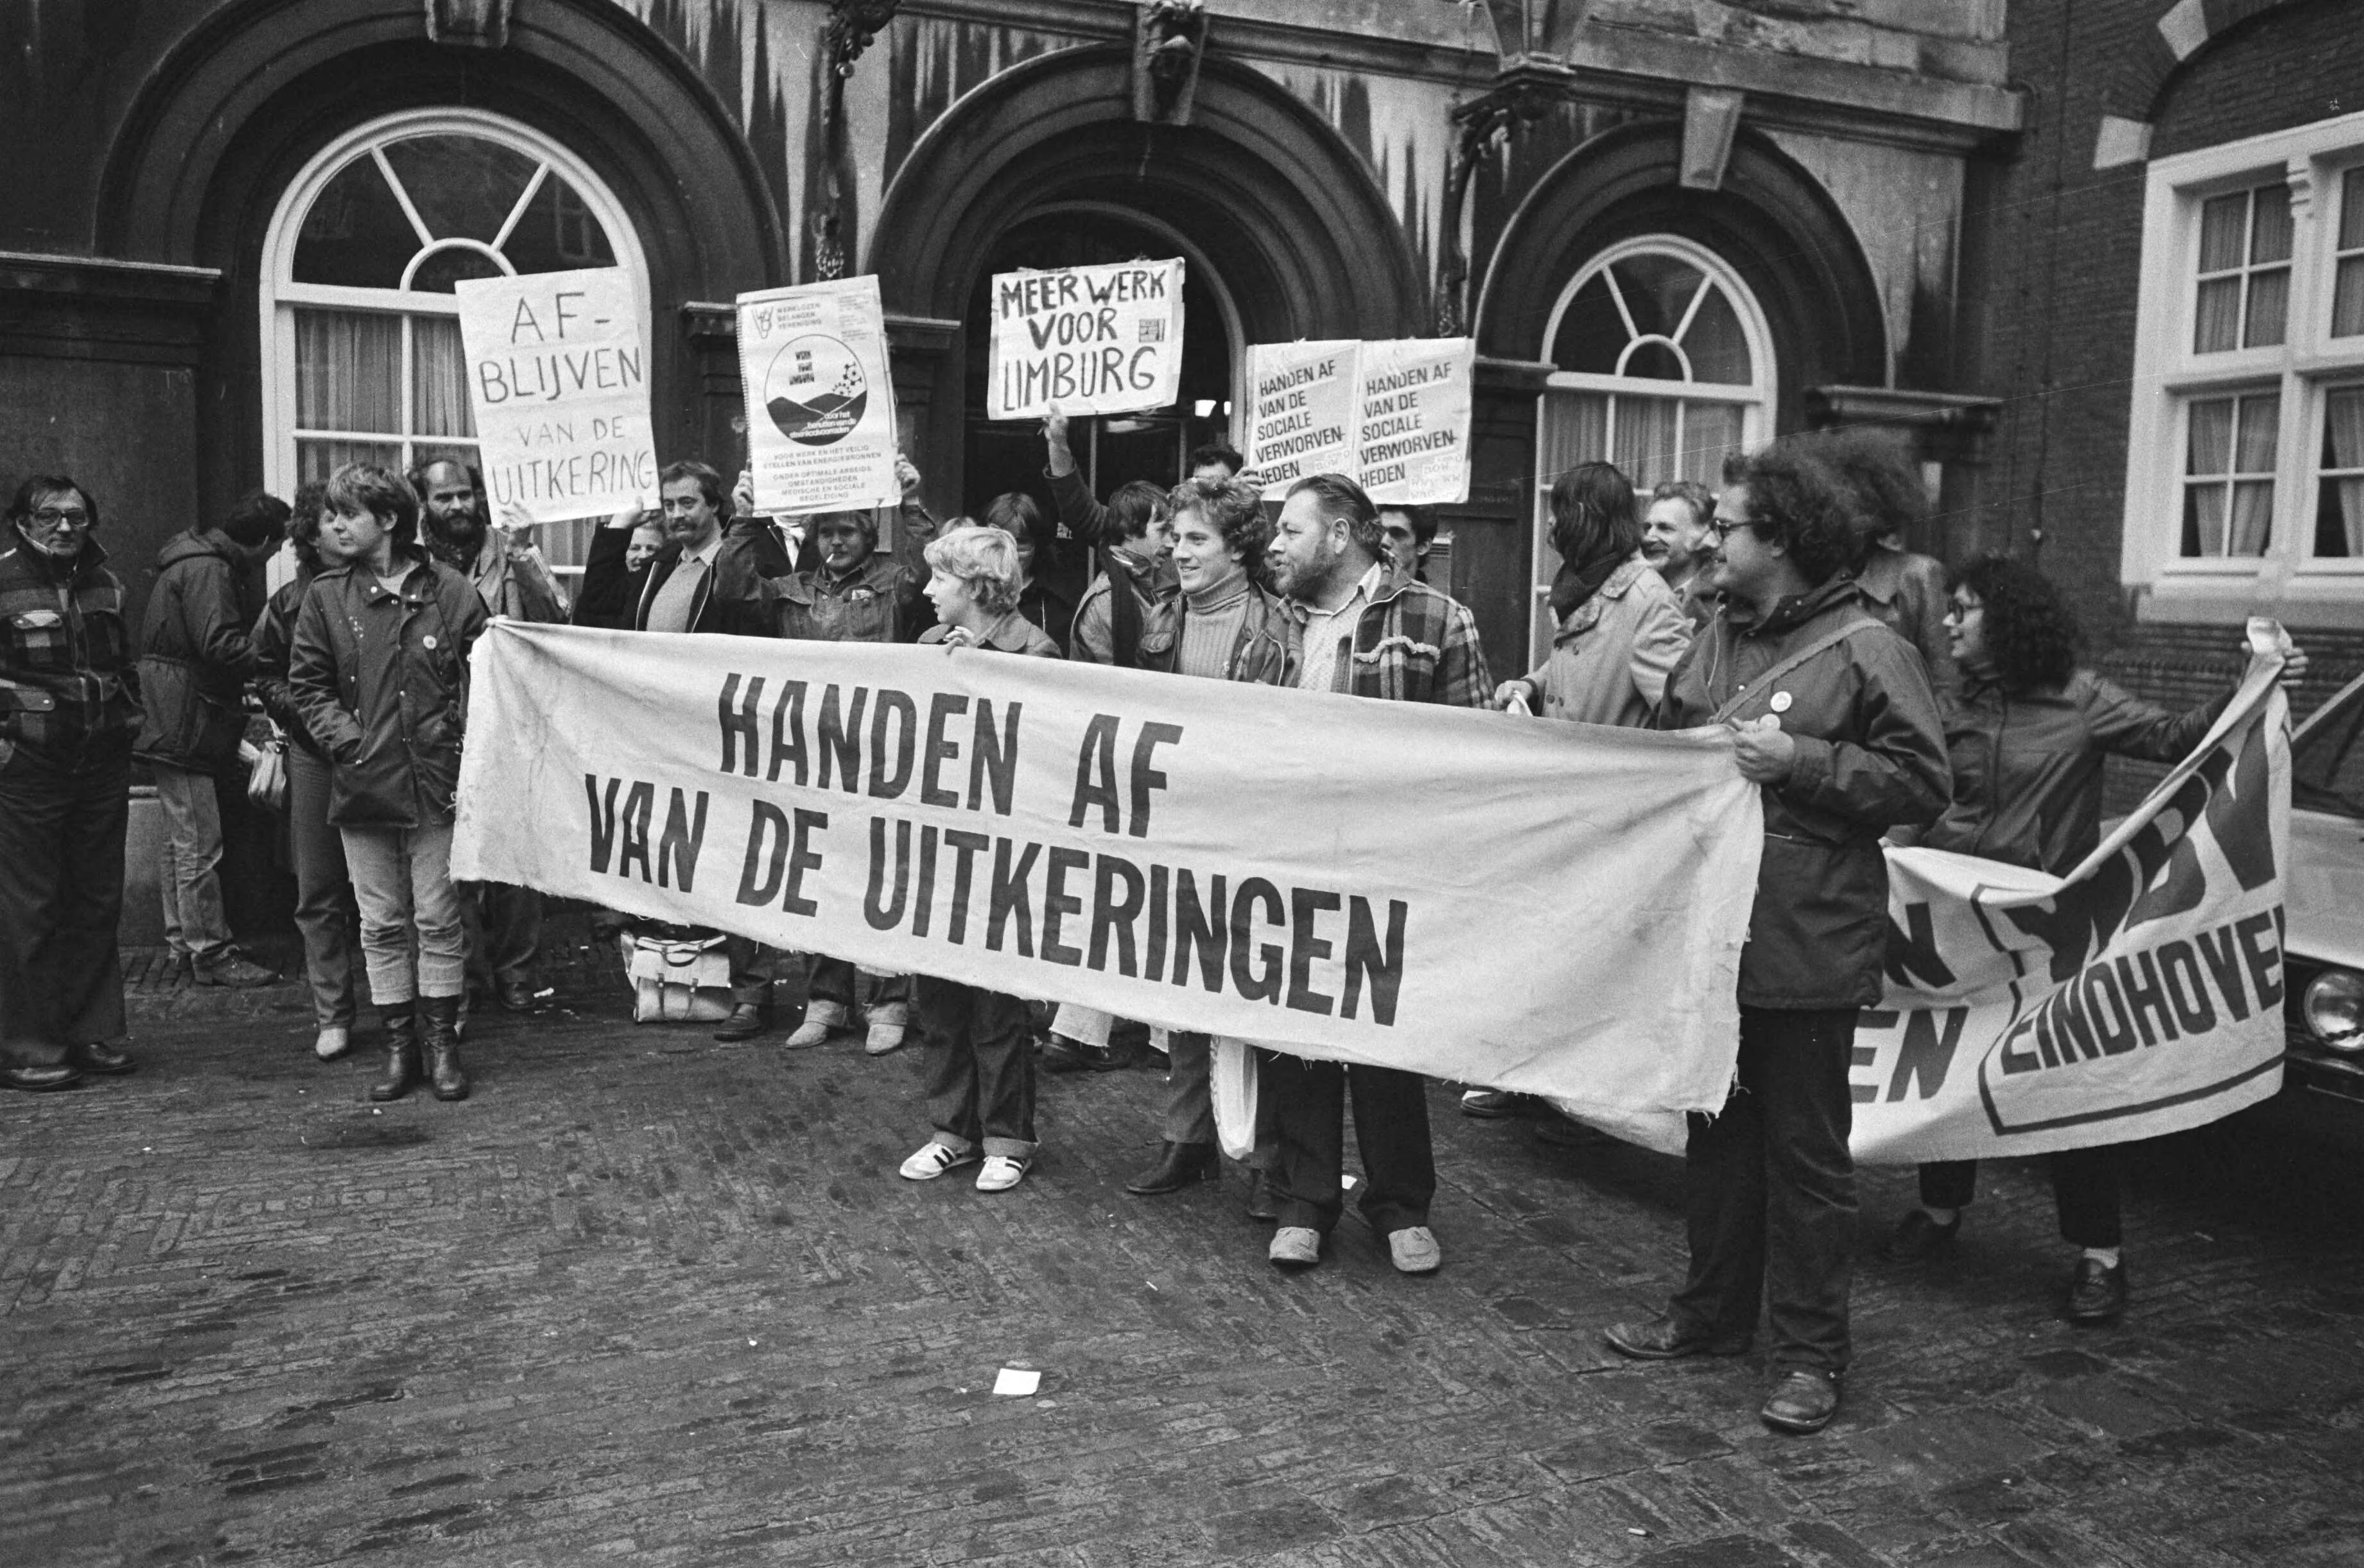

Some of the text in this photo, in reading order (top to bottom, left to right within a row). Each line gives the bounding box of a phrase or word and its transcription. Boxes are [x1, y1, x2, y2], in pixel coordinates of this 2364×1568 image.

[1000, 270, 1166, 319] MEER WERK
[1026, 308, 1118, 350] VOOR
[479, 347, 642, 403] BLIJVEN
[1004, 345, 1156, 412] LIMBURG
[1259, 360, 1336, 397] HANDEN AF
[1366, 362, 1452, 396] HANDEN AF
[1258, 390, 1307, 419] VAN DE
[1364, 392, 1419, 419] VAN DE
[518, 415, 625, 447] VAN DE
[1256, 424, 1346, 464] VERWORVEN-
[1257, 411, 1313, 441] SOCIALE
[1362, 414, 1423, 442] SOCIALE
[797, 458, 813, 467] VAN
[846, 445, 869, 453] VEILIG
[1360, 429, 1458, 466] VERWORVEN-
[493, 450, 654, 505] UITKERING
[833, 482, 866, 491] SOCIALE
[1359, 462, 1406, 489] HEDEN
[718, 673, 1184, 838] HANDEN AF
[586, 774, 1408, 1027] VAN DE UITKERINGEN
[2001, 902, 2286, 1076] EINDHOVE
